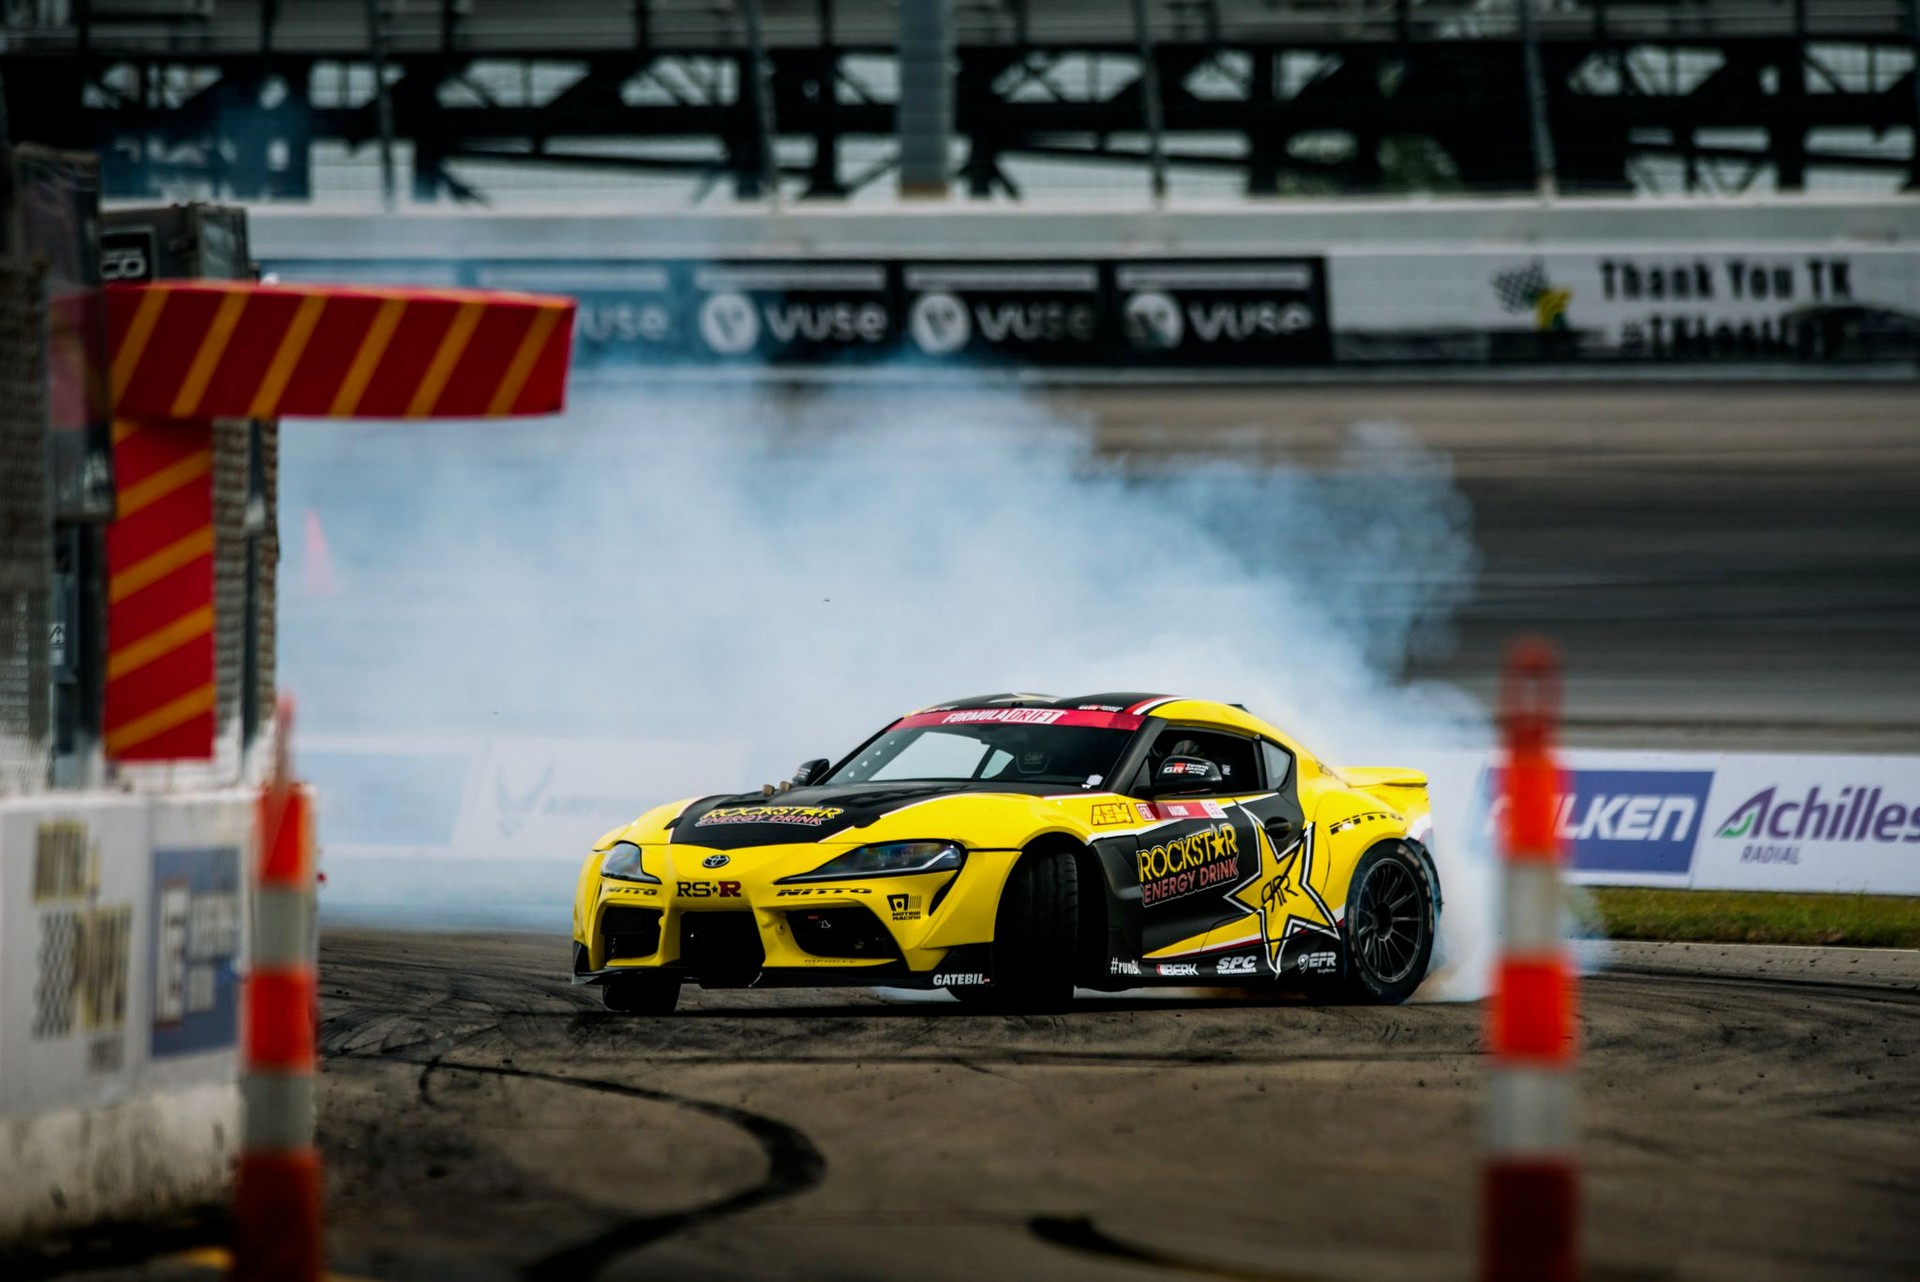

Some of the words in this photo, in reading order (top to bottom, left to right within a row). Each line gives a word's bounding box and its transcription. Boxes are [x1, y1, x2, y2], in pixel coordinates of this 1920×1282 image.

[1143, 869, 1196, 903] ENERGY
[1200, 857, 1237, 887] DRINK
[776, 888, 873, 897] NITTO
[1216, 955, 1257, 970] SPC
[1308, 952, 1337, 968] EFR
